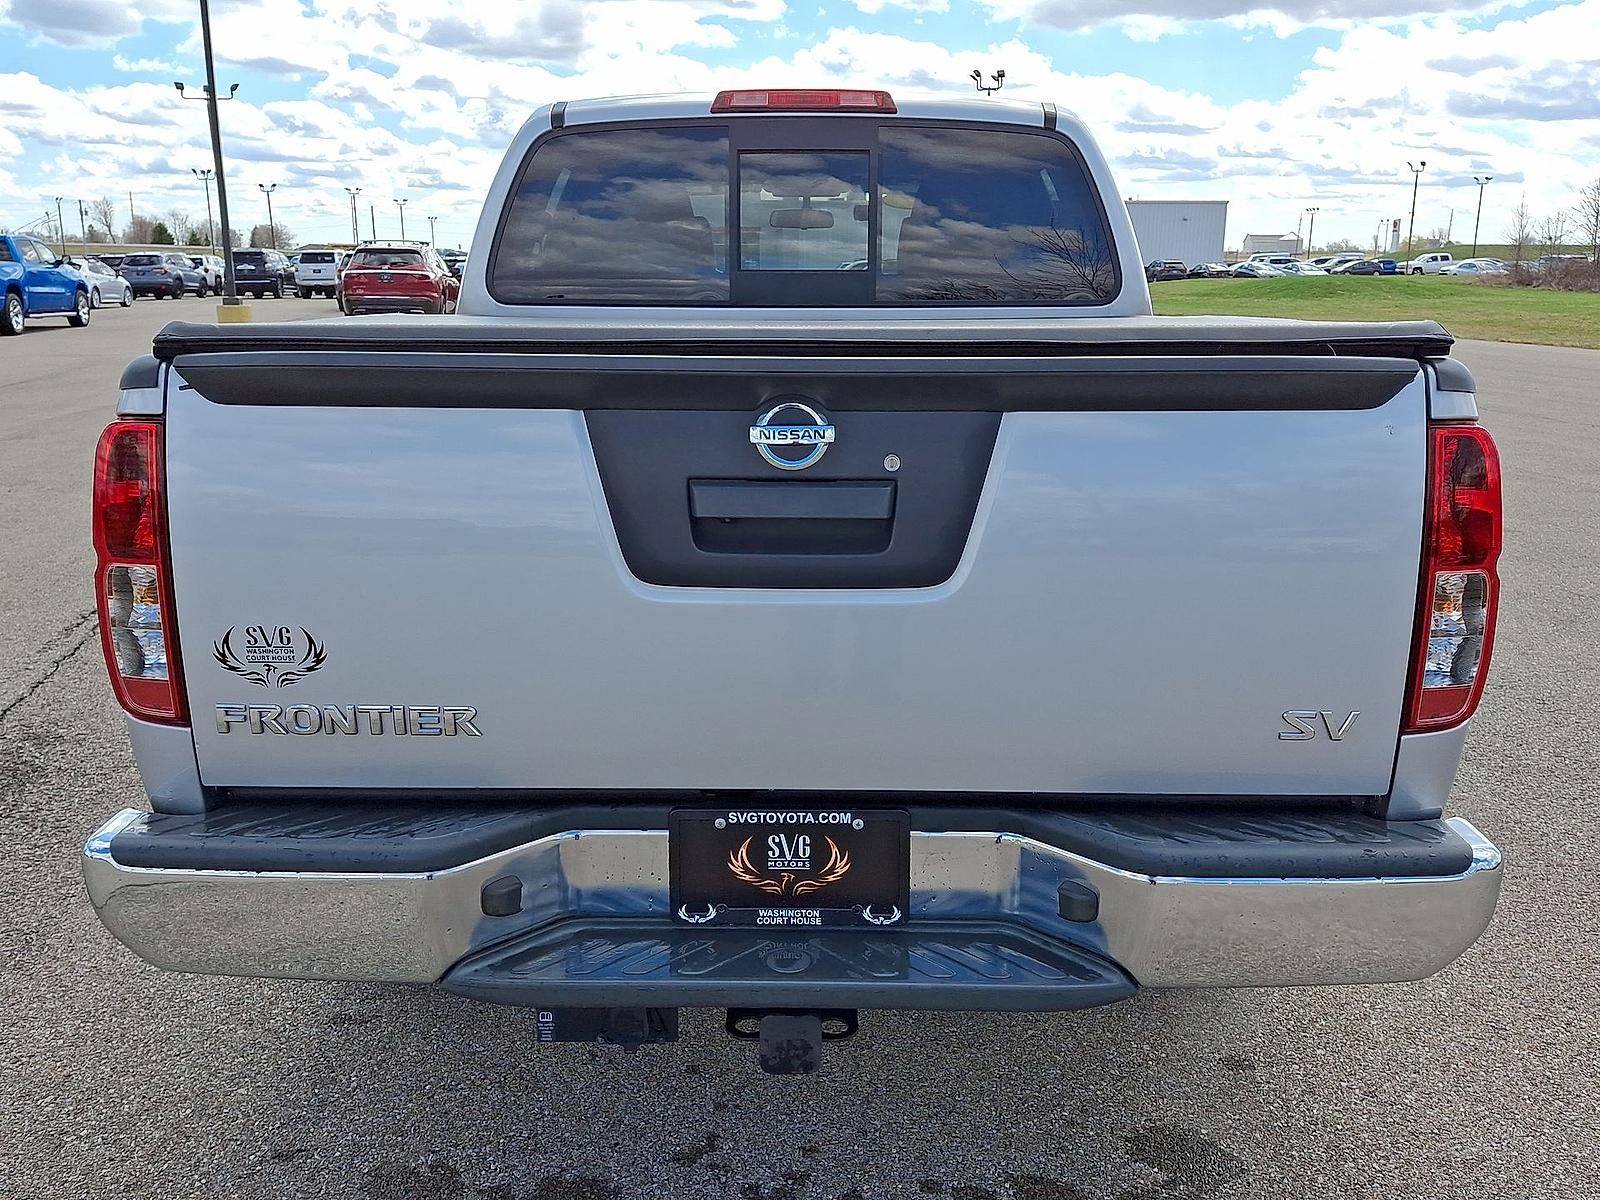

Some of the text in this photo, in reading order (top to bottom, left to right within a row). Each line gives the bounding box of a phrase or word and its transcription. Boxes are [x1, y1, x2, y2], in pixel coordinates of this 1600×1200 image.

[759, 429, 826, 441] NISSAN
[245, 625, 292, 648] SVG
[215, 703, 483, 737] FRONTIER
[1278, 710, 1361, 741] SV
[728, 812, 852, 824] SVGTOYOTA.COM
[767, 833, 811, 861] SVG
[756, 917, 822, 926] COURT HOUSE
[758, 909, 820, 918] WASHINGTON
